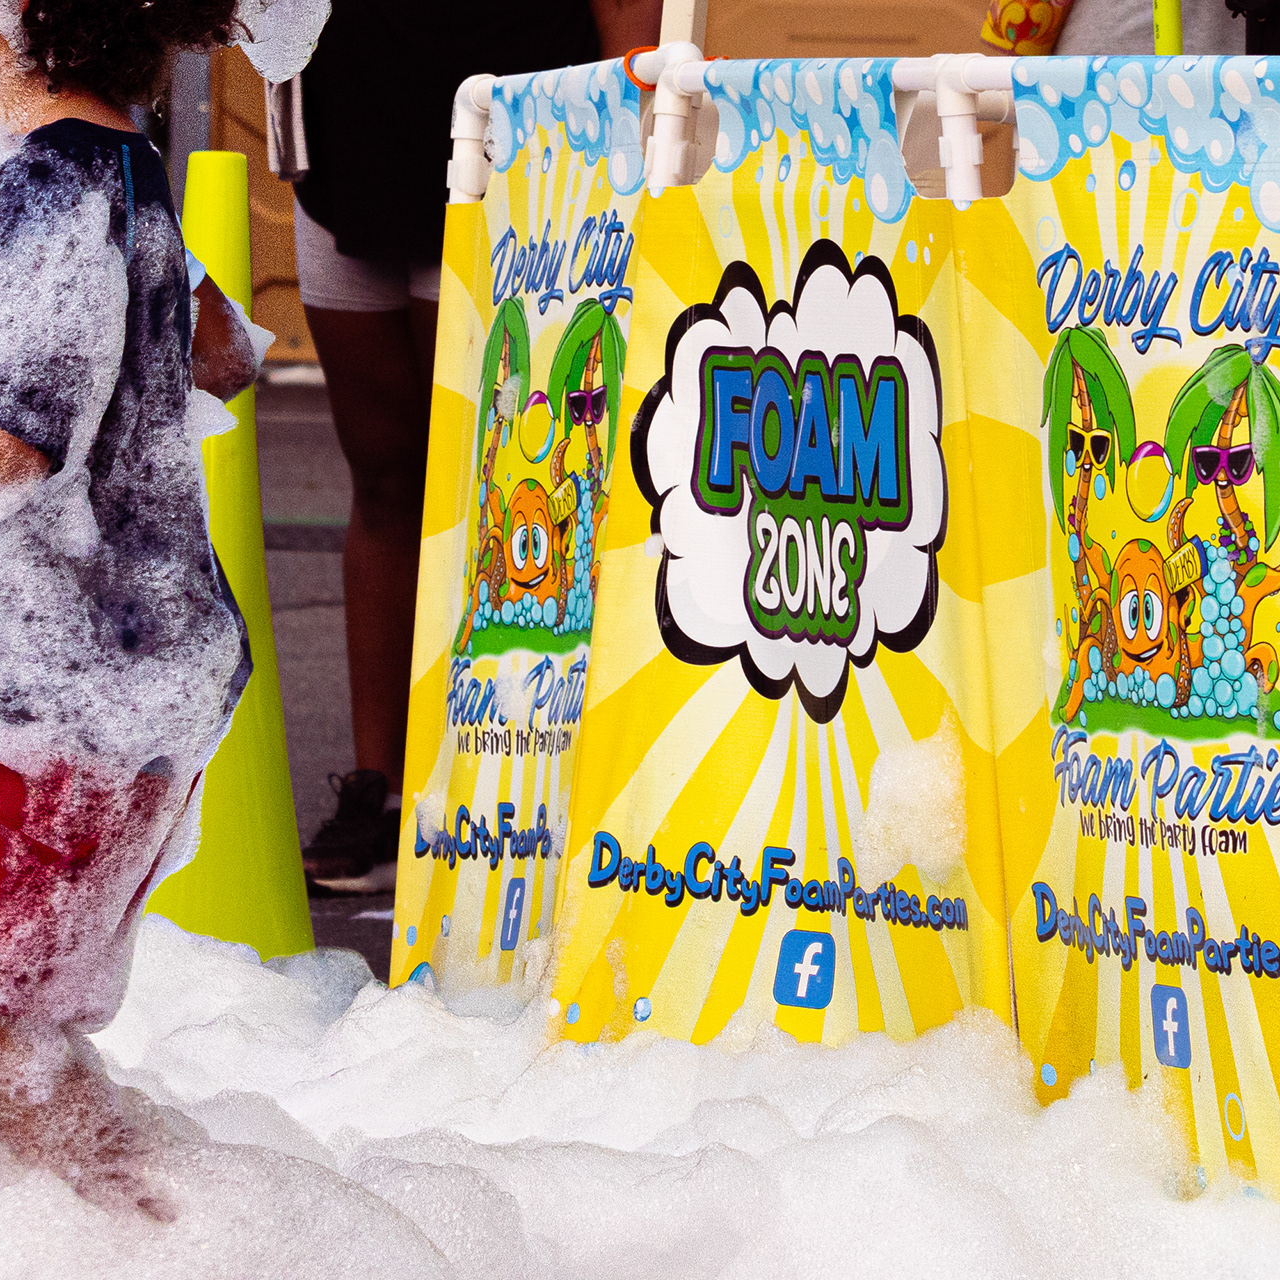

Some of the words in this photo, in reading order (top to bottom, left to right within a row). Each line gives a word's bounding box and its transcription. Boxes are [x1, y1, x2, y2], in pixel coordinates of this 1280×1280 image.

[490, 219, 566, 315] Derby
[567, 208, 635, 315] City
[1036, 242, 1183, 355] Derby
[708, 364, 900, 505] FOAM
[753, 512, 857, 620] ZONE
[1051, 724, 1137, 813] Foam
[413, 801, 556, 872] rbyCityFoamPa
[587, 830, 970, 932] DerbyCityFoamParties.com
[1139, 816, 1158, 849] the
